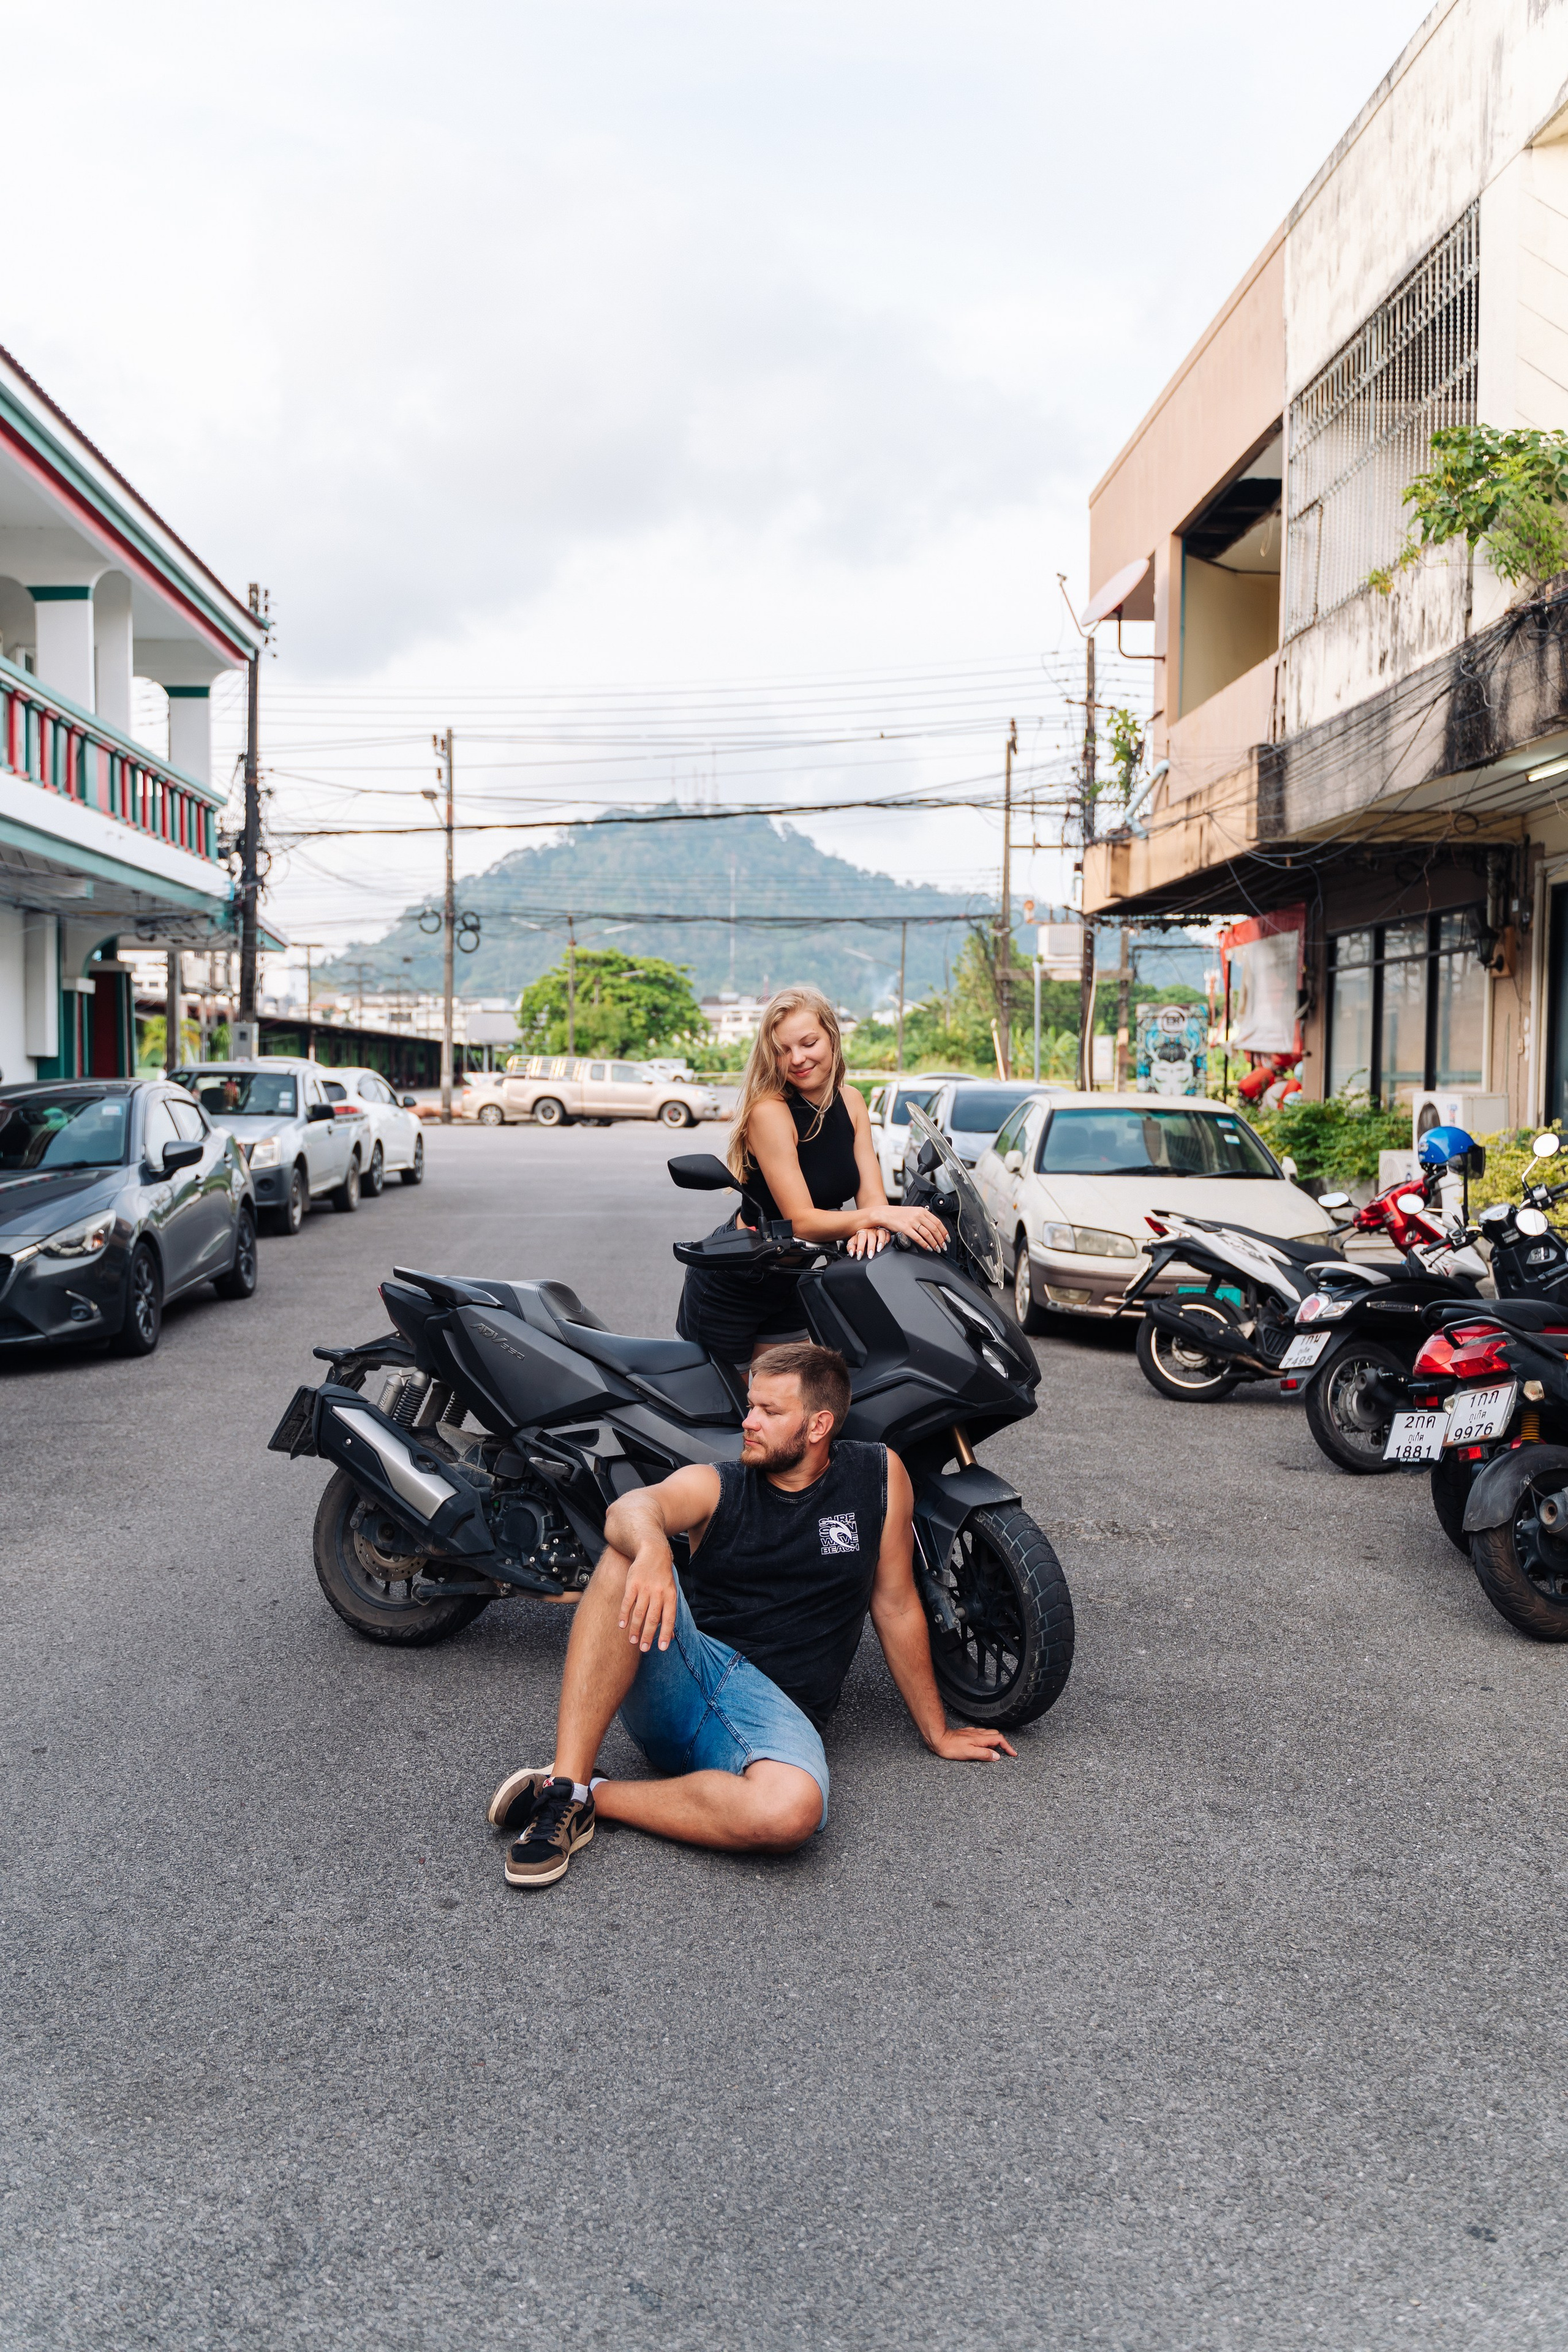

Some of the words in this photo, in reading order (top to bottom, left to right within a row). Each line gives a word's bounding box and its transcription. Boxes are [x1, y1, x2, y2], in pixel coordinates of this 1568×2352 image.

[1470, 1390, 1499, 1408] 1กภ
[1404, 1415, 1436, 1428] 2กค
[1469, 1409, 1487, 1423] ภูเก็ต
[1408, 1431, 1424, 1444] ภูเก็ต
[1453, 1422, 1494, 1441] 9976
[1396, 1446, 1432, 1458] 1881
[818, 1512, 855, 1527] SURF
